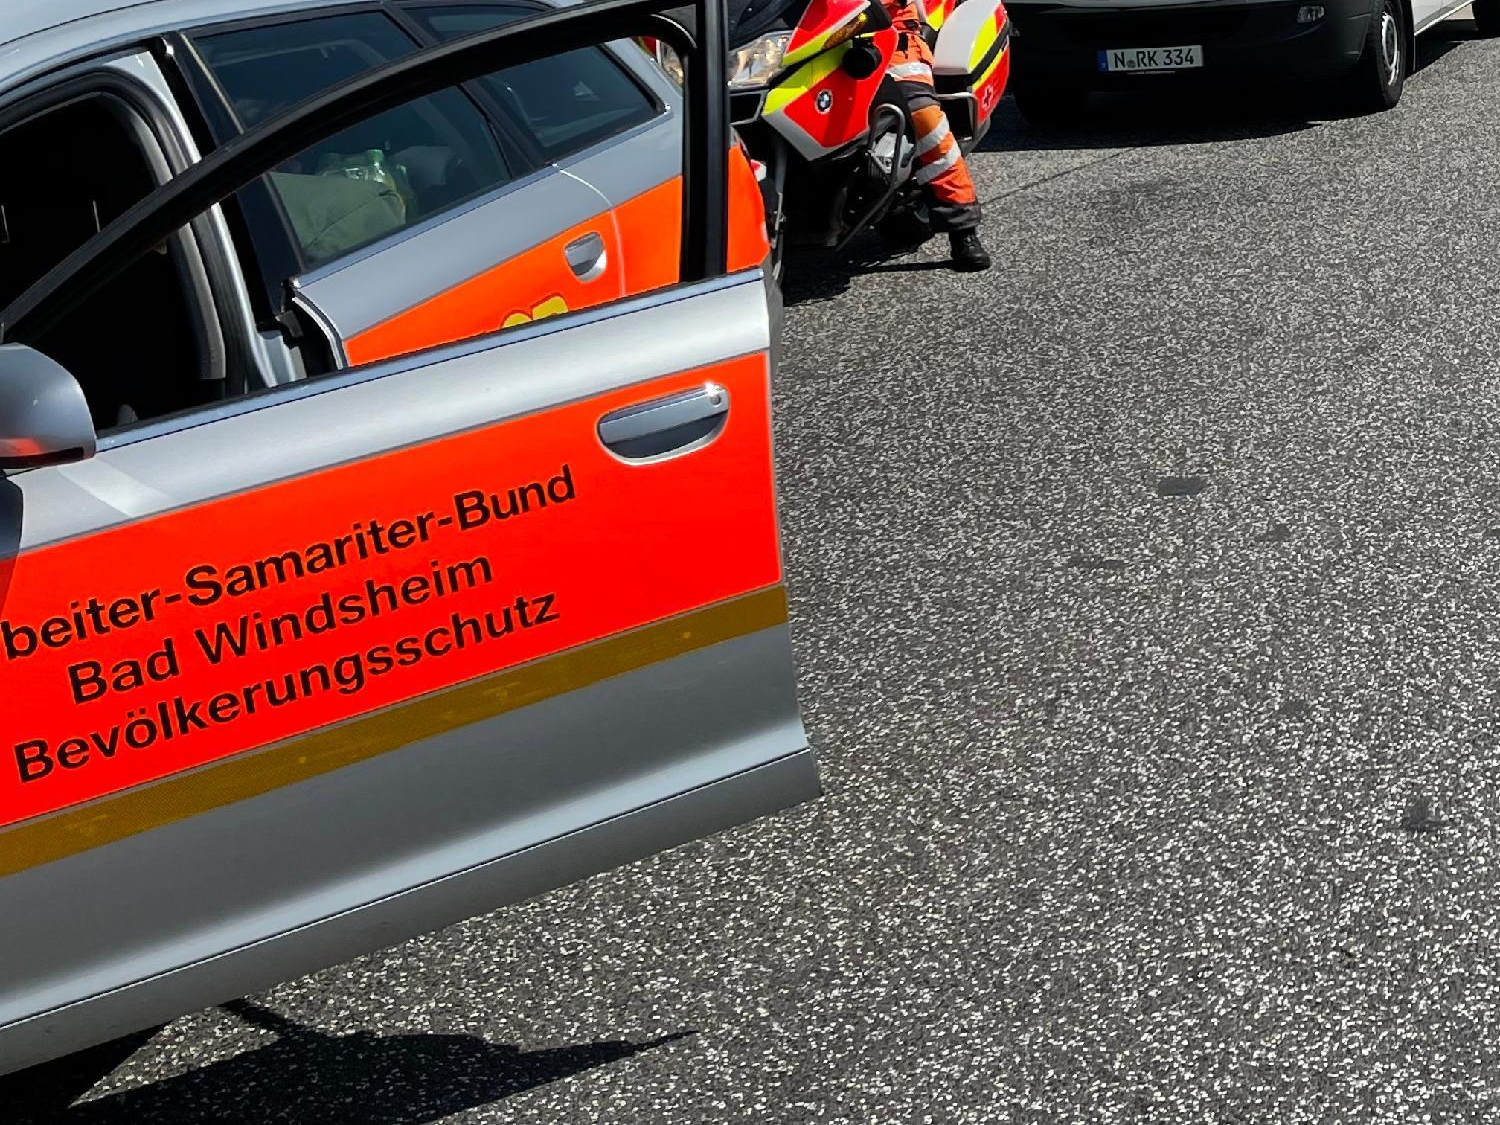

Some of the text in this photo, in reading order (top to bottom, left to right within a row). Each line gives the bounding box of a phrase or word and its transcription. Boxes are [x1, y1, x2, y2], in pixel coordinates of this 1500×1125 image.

[1162, 48, 1195, 66] 334
[0, 465, 576, 660] beiter-Samariter-Bund
[67, 556, 493, 704] Bad Windsheim
[14, 592, 560, 782] Bevölkerungsschutz
